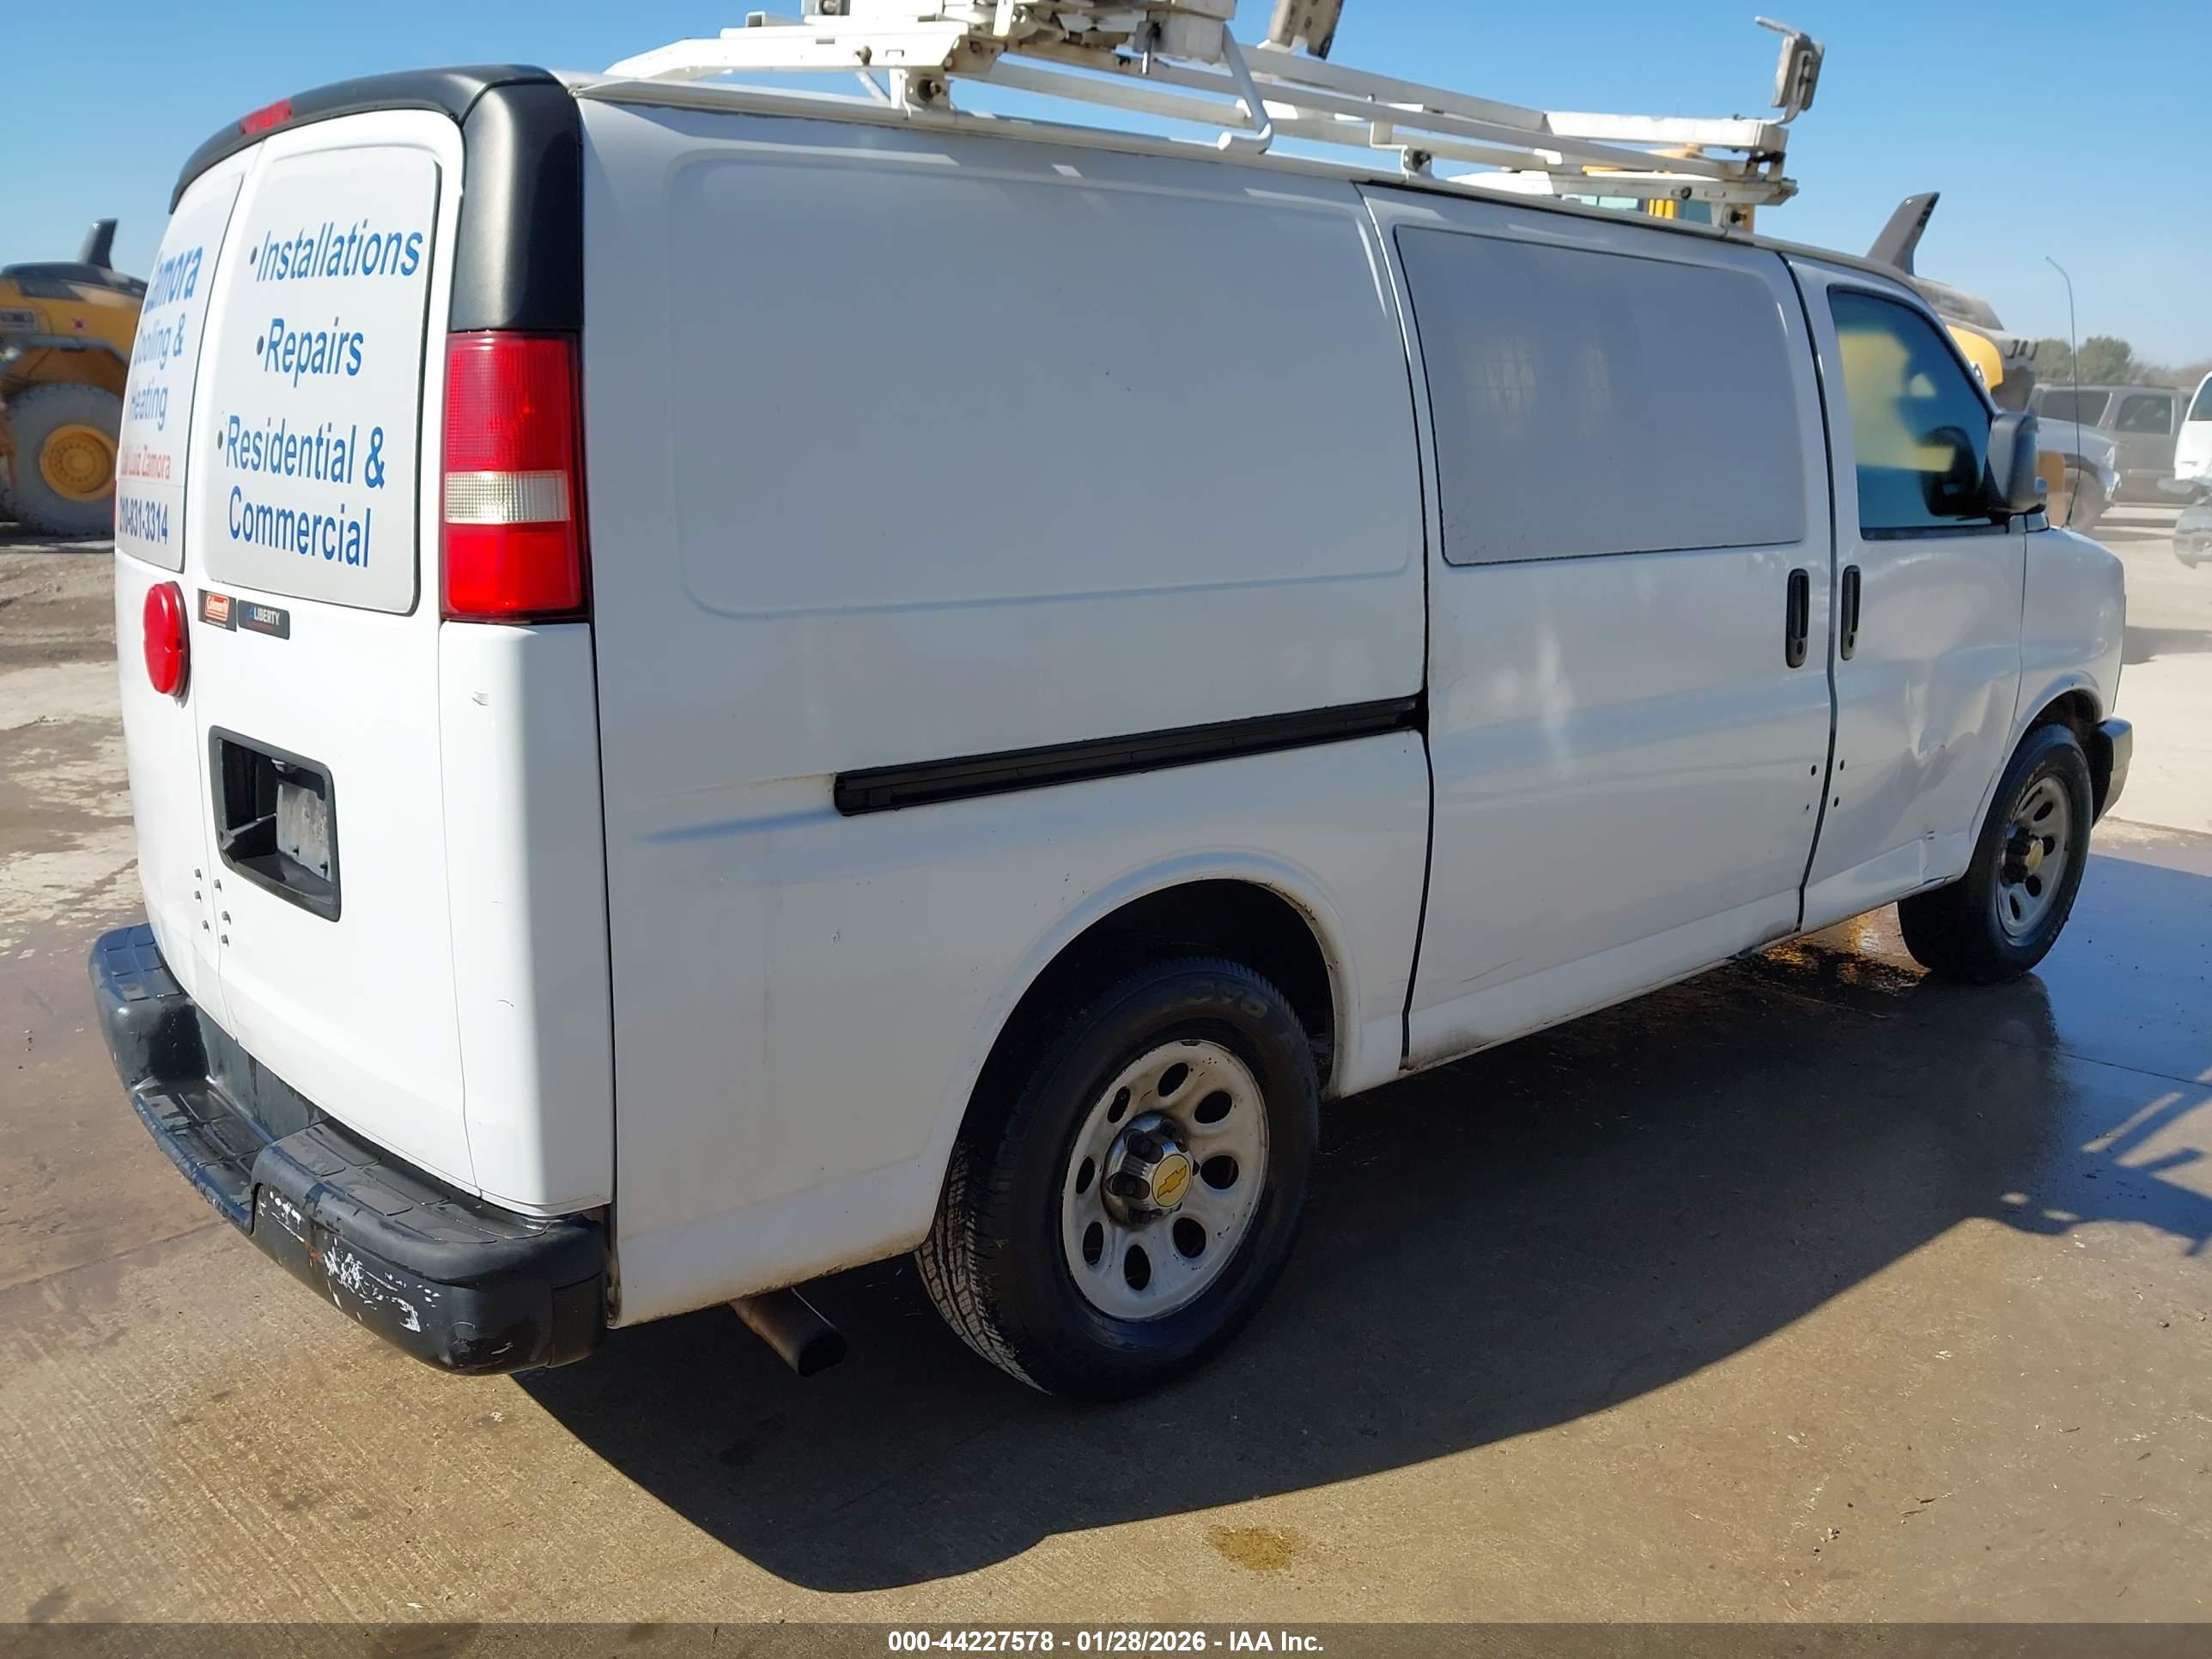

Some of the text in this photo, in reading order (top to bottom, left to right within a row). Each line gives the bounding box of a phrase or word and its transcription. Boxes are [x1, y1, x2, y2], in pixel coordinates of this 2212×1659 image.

[257, 218, 422, 282] Installations
[173, 312, 185, 357] &
[264, 316, 363, 388] Repairs
[129, 376, 167, 432] Heating
[226, 415, 385, 489] Residential &
[229, 485, 371, 568] Commercial
[253, 605, 280, 626] LIBERTY
